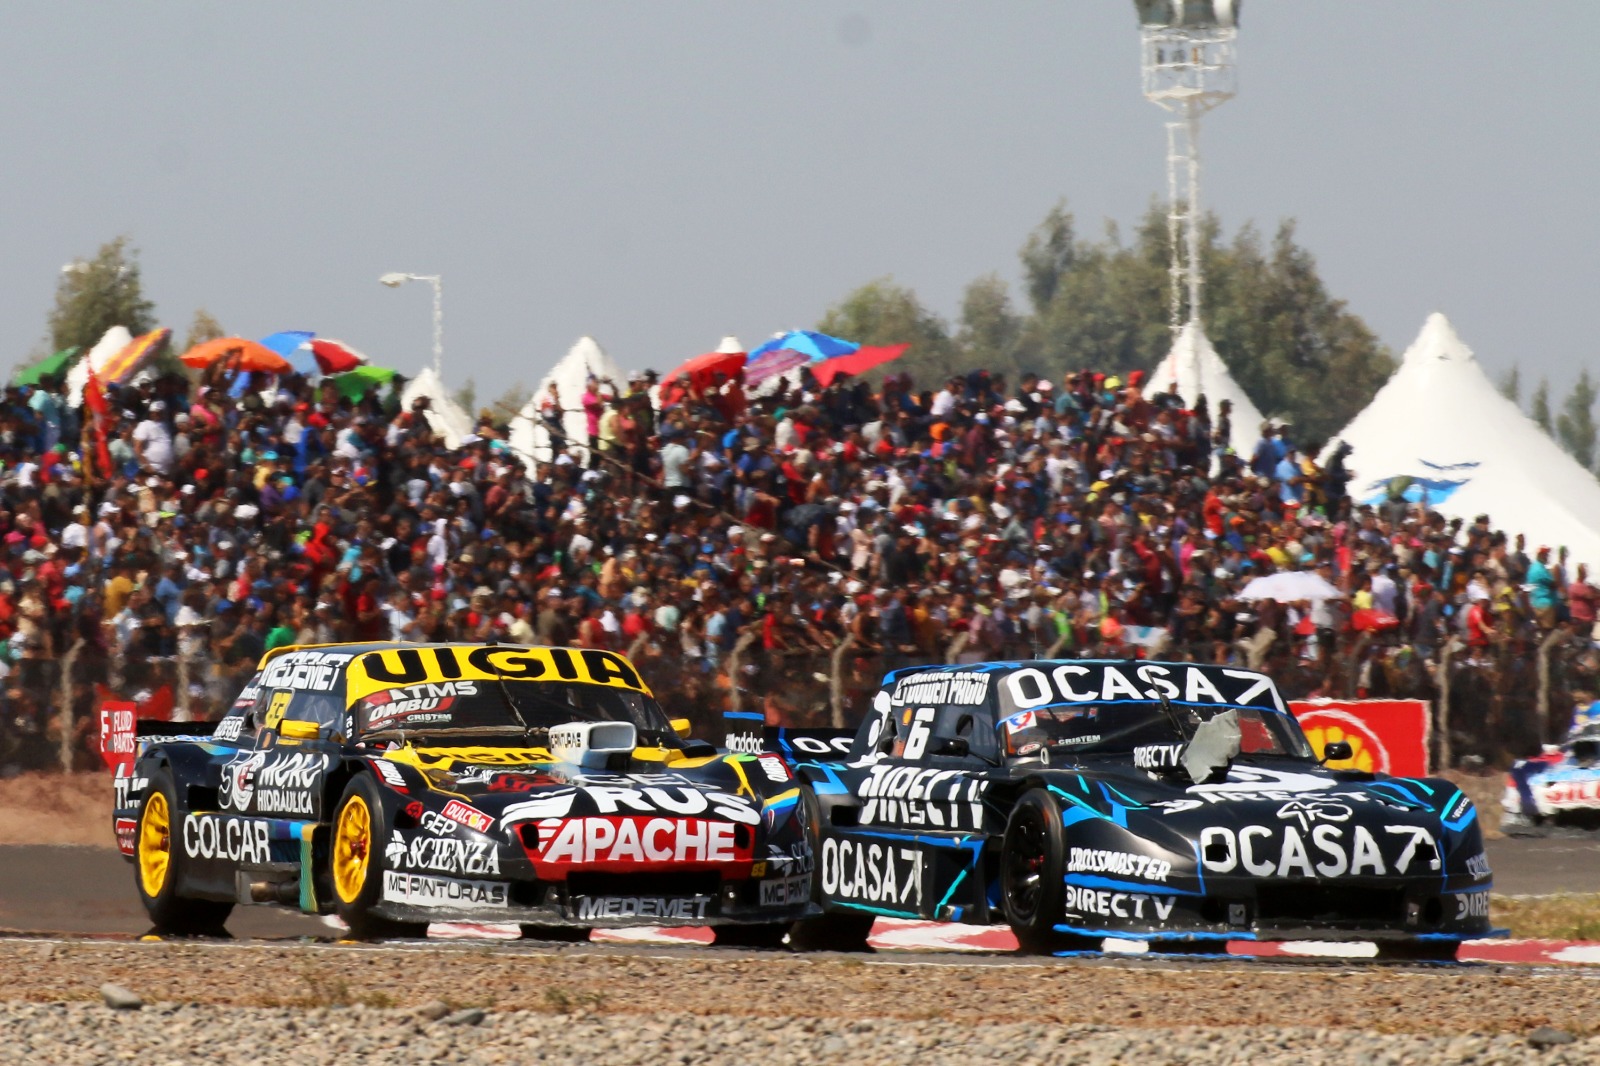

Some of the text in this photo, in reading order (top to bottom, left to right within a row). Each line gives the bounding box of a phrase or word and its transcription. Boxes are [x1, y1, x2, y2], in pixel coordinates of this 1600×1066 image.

[369, 698, 439, 721] OMBU
[113, 733, 135, 753] PARTS
[903, 708, 935, 759] 6
[1058, 734, 1101, 745] CRISTEM
[421, 811, 457, 836] GEP
[183, 815, 271, 863] COLCAR
[541, 817, 735, 863] APACHE
[406, 836, 501, 874] SCIENZA
[578, 896, 711, 920] MEDEMET
